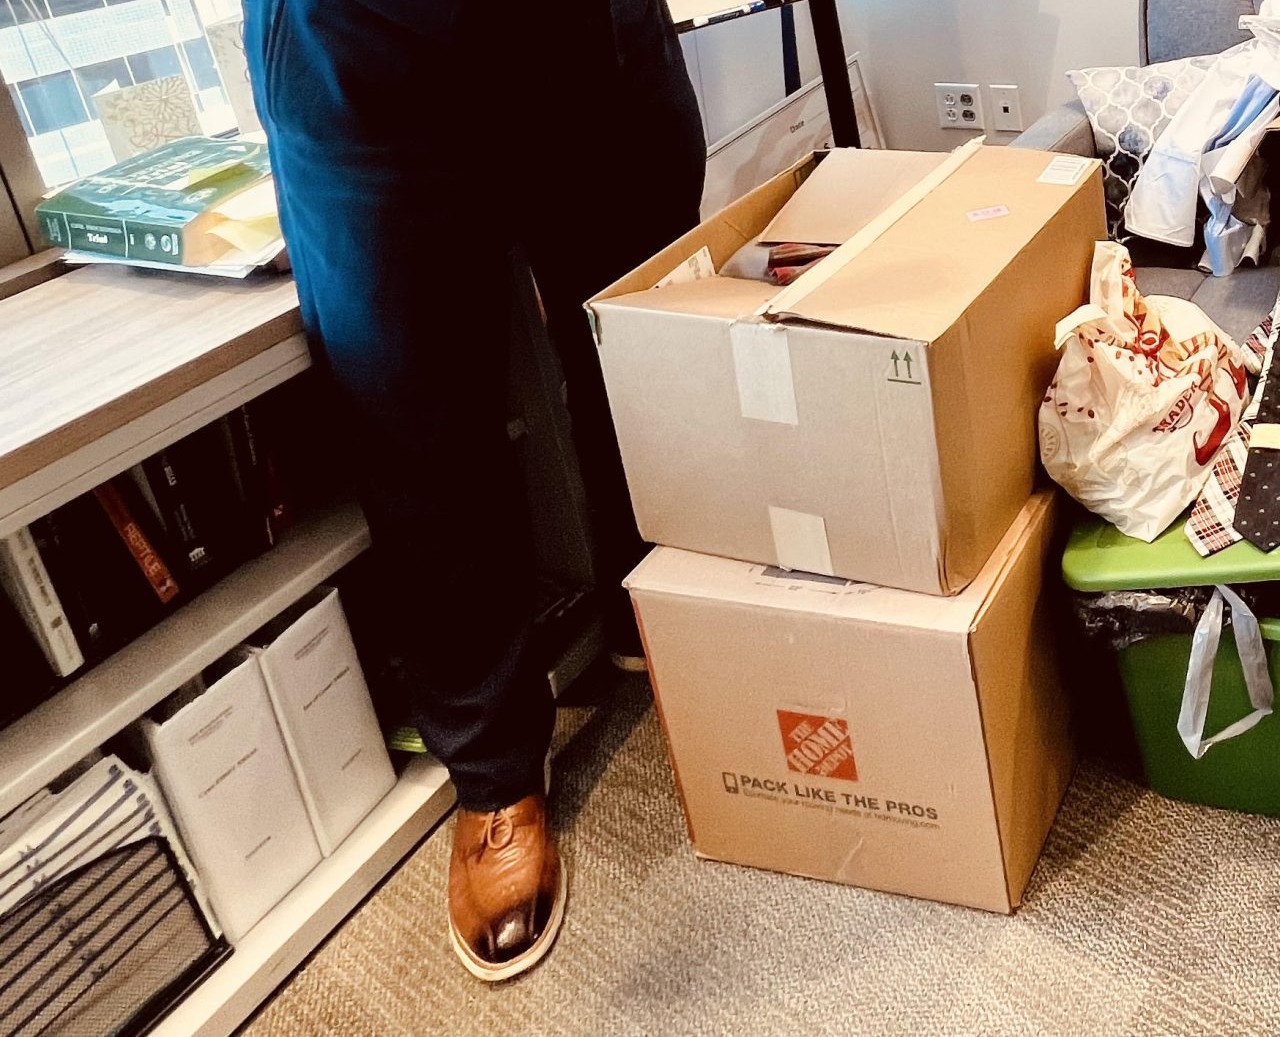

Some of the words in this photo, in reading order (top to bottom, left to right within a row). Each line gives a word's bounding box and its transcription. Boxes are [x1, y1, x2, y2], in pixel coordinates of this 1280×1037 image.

[790, 121, 804, 133] Date
[740, 774, 788, 794] PACK
[795, 785, 836, 803] LIKE
[841, 793, 880, 811] THE
[886, 800, 939, 820] PROS
